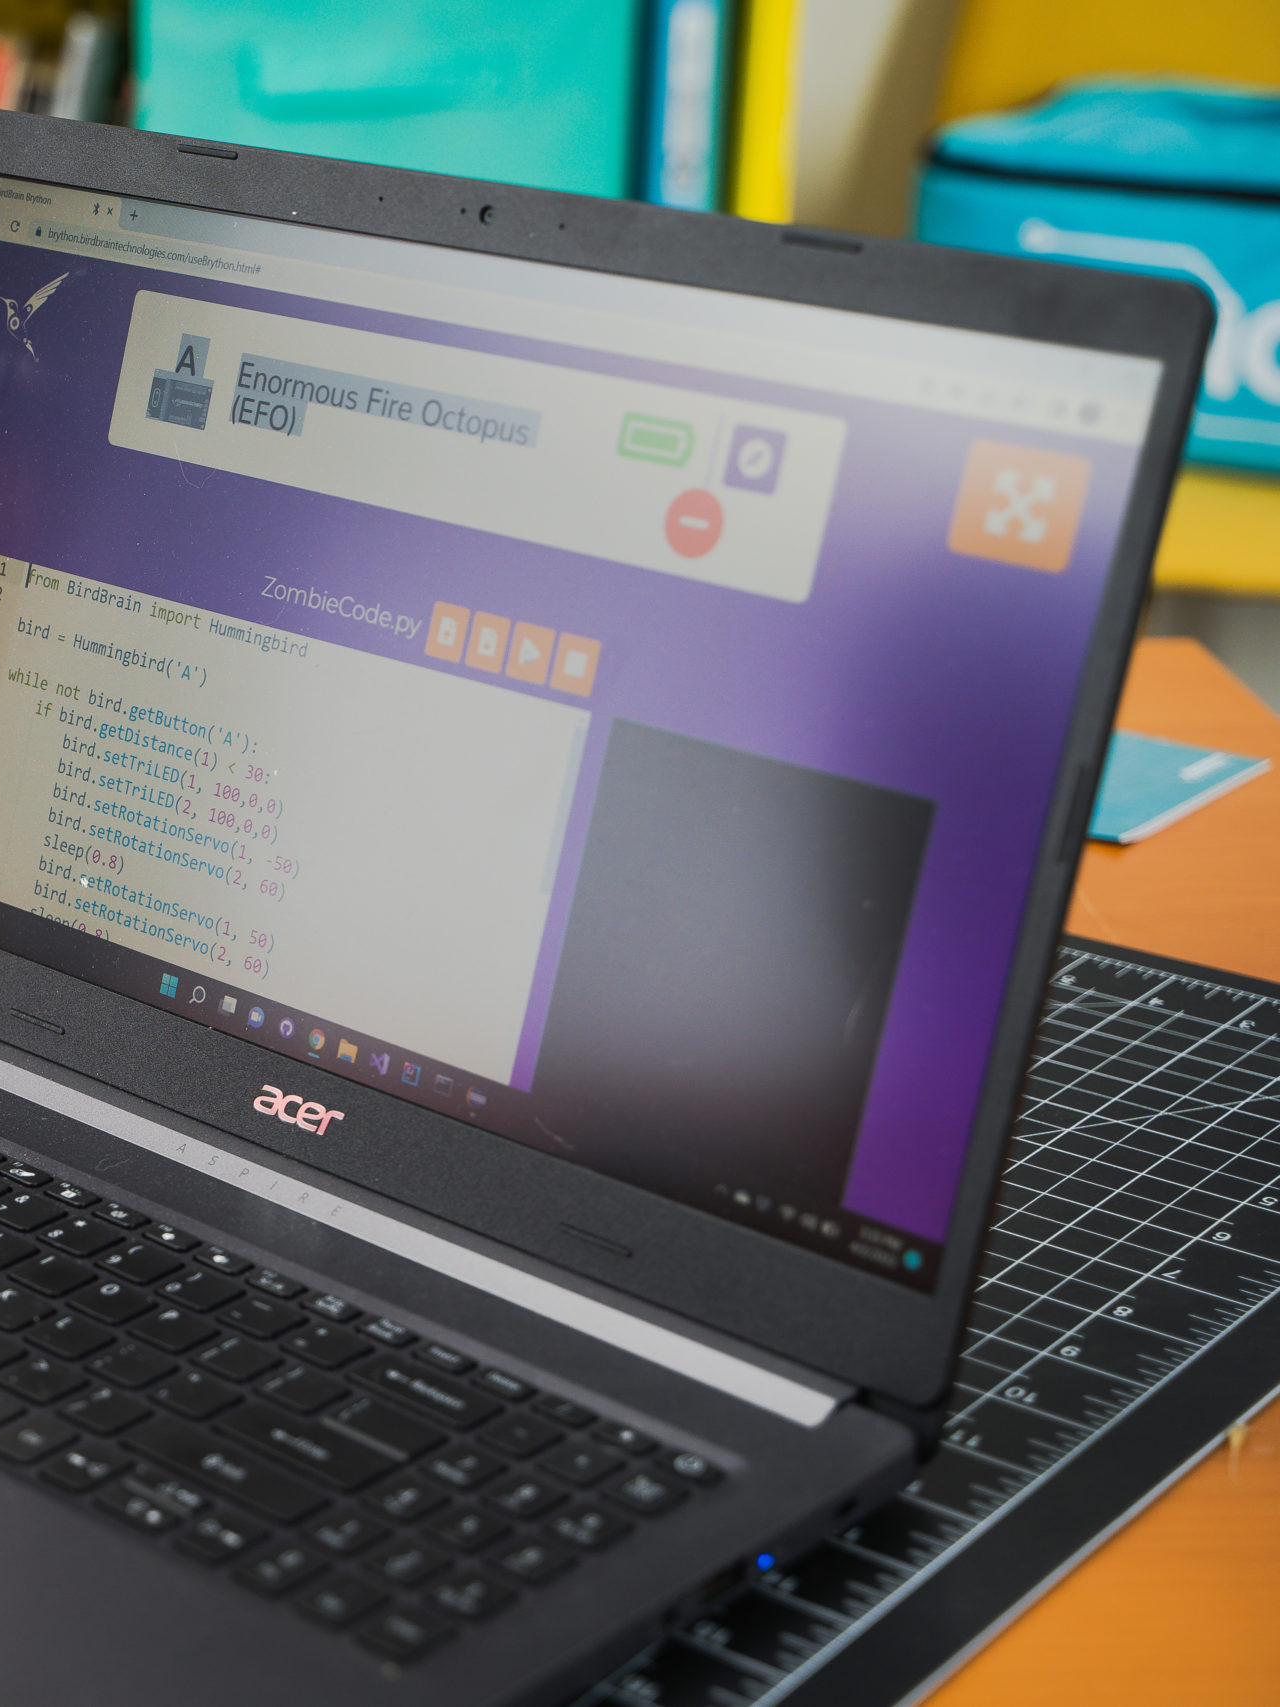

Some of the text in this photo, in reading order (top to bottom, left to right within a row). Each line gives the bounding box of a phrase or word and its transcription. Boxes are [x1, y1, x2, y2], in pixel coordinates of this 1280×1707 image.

[26, 193, 52, 205] Brython
[48, 227, 262, 275] brython.birdbraintechnologies.com/useBrython.html#
[175, 345, 196, 376] A
[230, 395, 297, 436] (EFO)
[237, 361, 531, 446] Enormous Fire Octopus
[0, 562, 309, 659] 1 from BirdBrain import Hummingbird
[260, 575, 423, 640] ZombieCode.py
[16, 617, 50, 641] bird
[57, 633, 66, 643] =
[72, 633, 209, 688] Hummingbird('A')
[7, 667, 49, 692] while
[55, 680, 81, 701] not
[87, 689, 259, 755] bird.getButton('A'):
[34, 700, 53, 718] if
[59, 706, 218, 773] bird.getDistance(1)
[227, 762, 237, 775] <
[244, 764, 271, 785] 30:
[57, 758, 198, 820] bird.setTriLED(2,
[208, 807, 279, 845] 100,0,0)
[61, 733, 203, 795] bird.setTriLED(1,
[213, 782, 284, 819] 100,0,0)
[43, 833, 125, 876] sleep(0.8)
[47, 806, 248, 891] bird.setRotationServo(2,
[259, 878, 286, 902] 60)
[52, 782, 253, 865] bird.setRotationServo(1,
[265, 854, 301, 880] -50)
[33, 880, 232, 968] bird.setRotationServo(2,
[243, 955, 271, 980] 60)
[38, 855, 237, 942] bird.setRotationServo(1,
[248, 929, 276, 954] 50)
[253, 1084, 345, 1136] acer
[1258, 1196, 1279, 1206] 5
[101, 1284, 119, 1294] O
[1161, 1269, 1183, 1280] 7
[1112, 1305, 1134, 1317] 8
